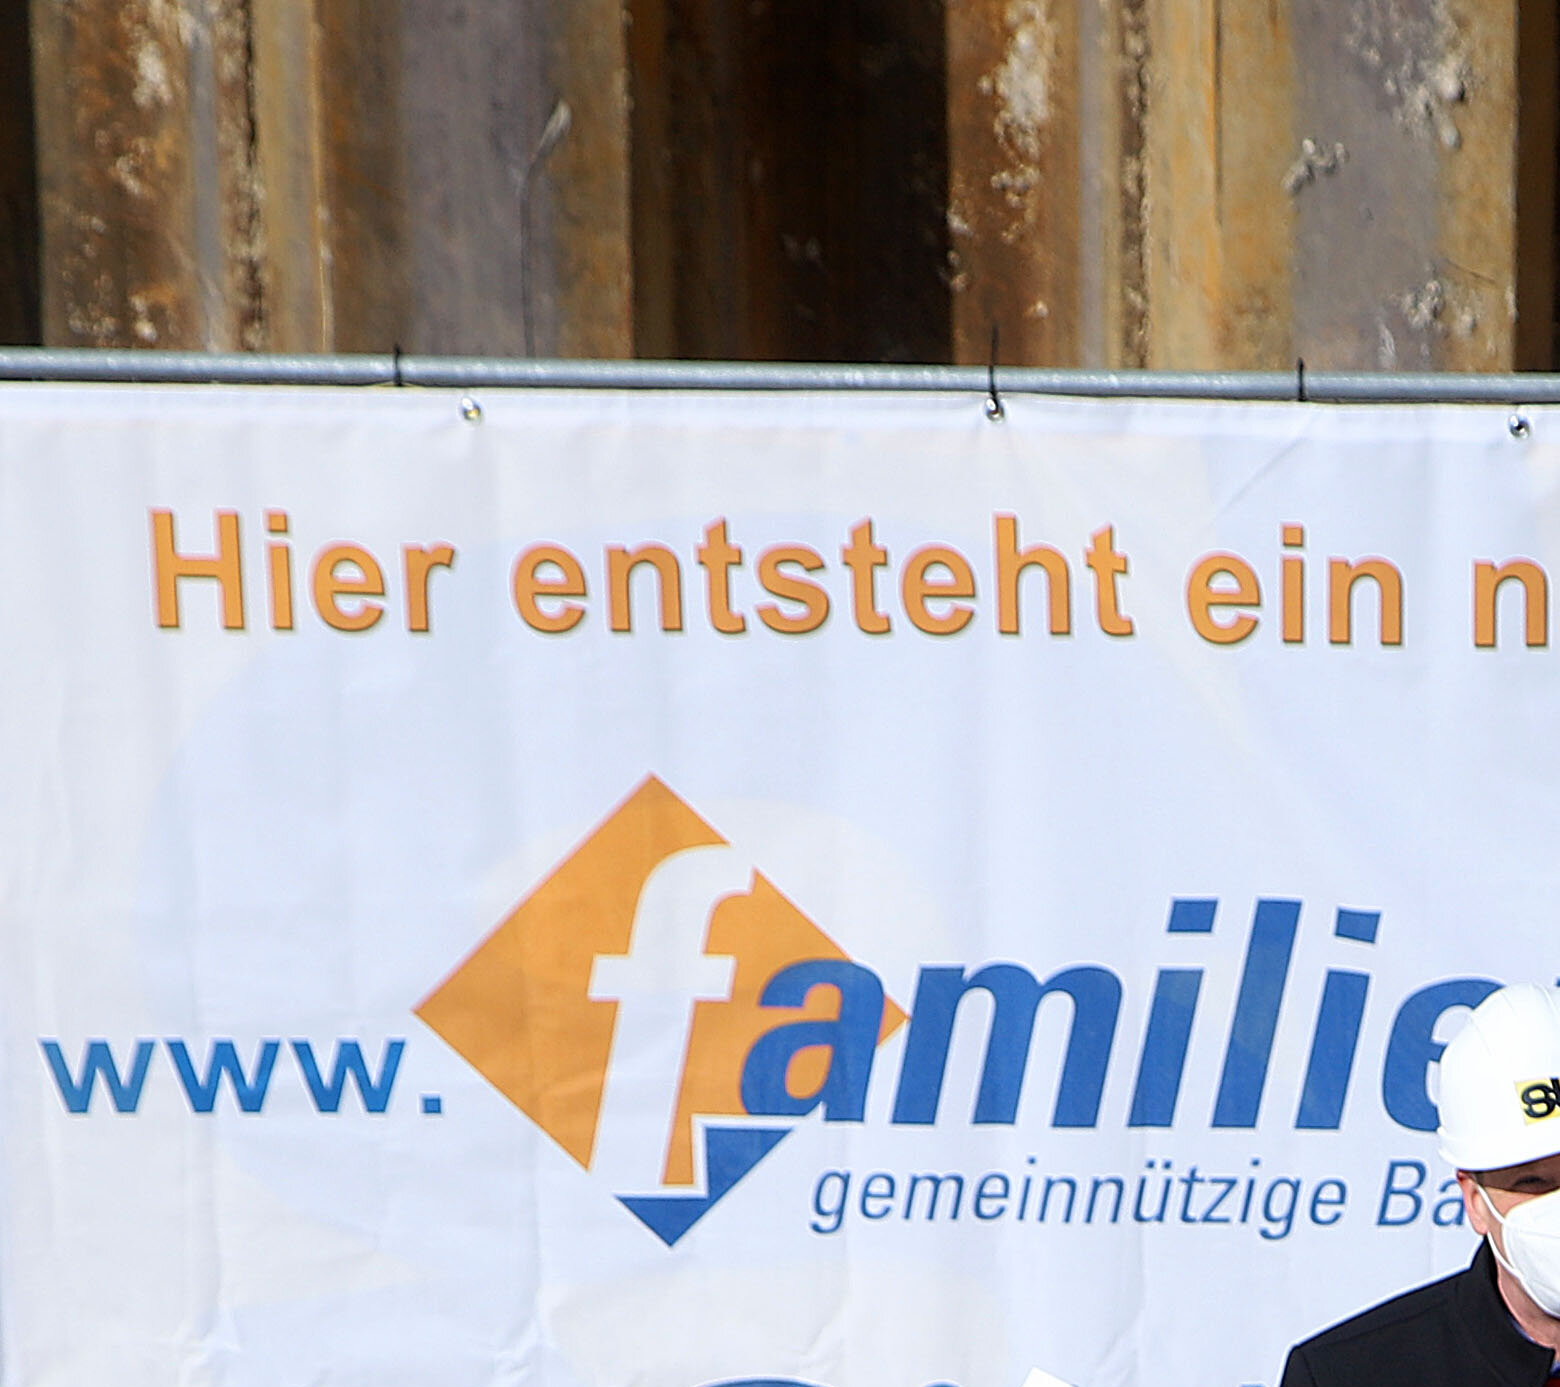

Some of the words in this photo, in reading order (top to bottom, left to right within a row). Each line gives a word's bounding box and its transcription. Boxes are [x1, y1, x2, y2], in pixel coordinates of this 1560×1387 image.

[148, 506, 456, 635] Hier
[513, 511, 1137, 641] entsteht
[1187, 523, 1404, 648] ein
[810, 1156, 1349, 1240] gemeinnützige
[1375, 1160, 1466, 1227] Ba
